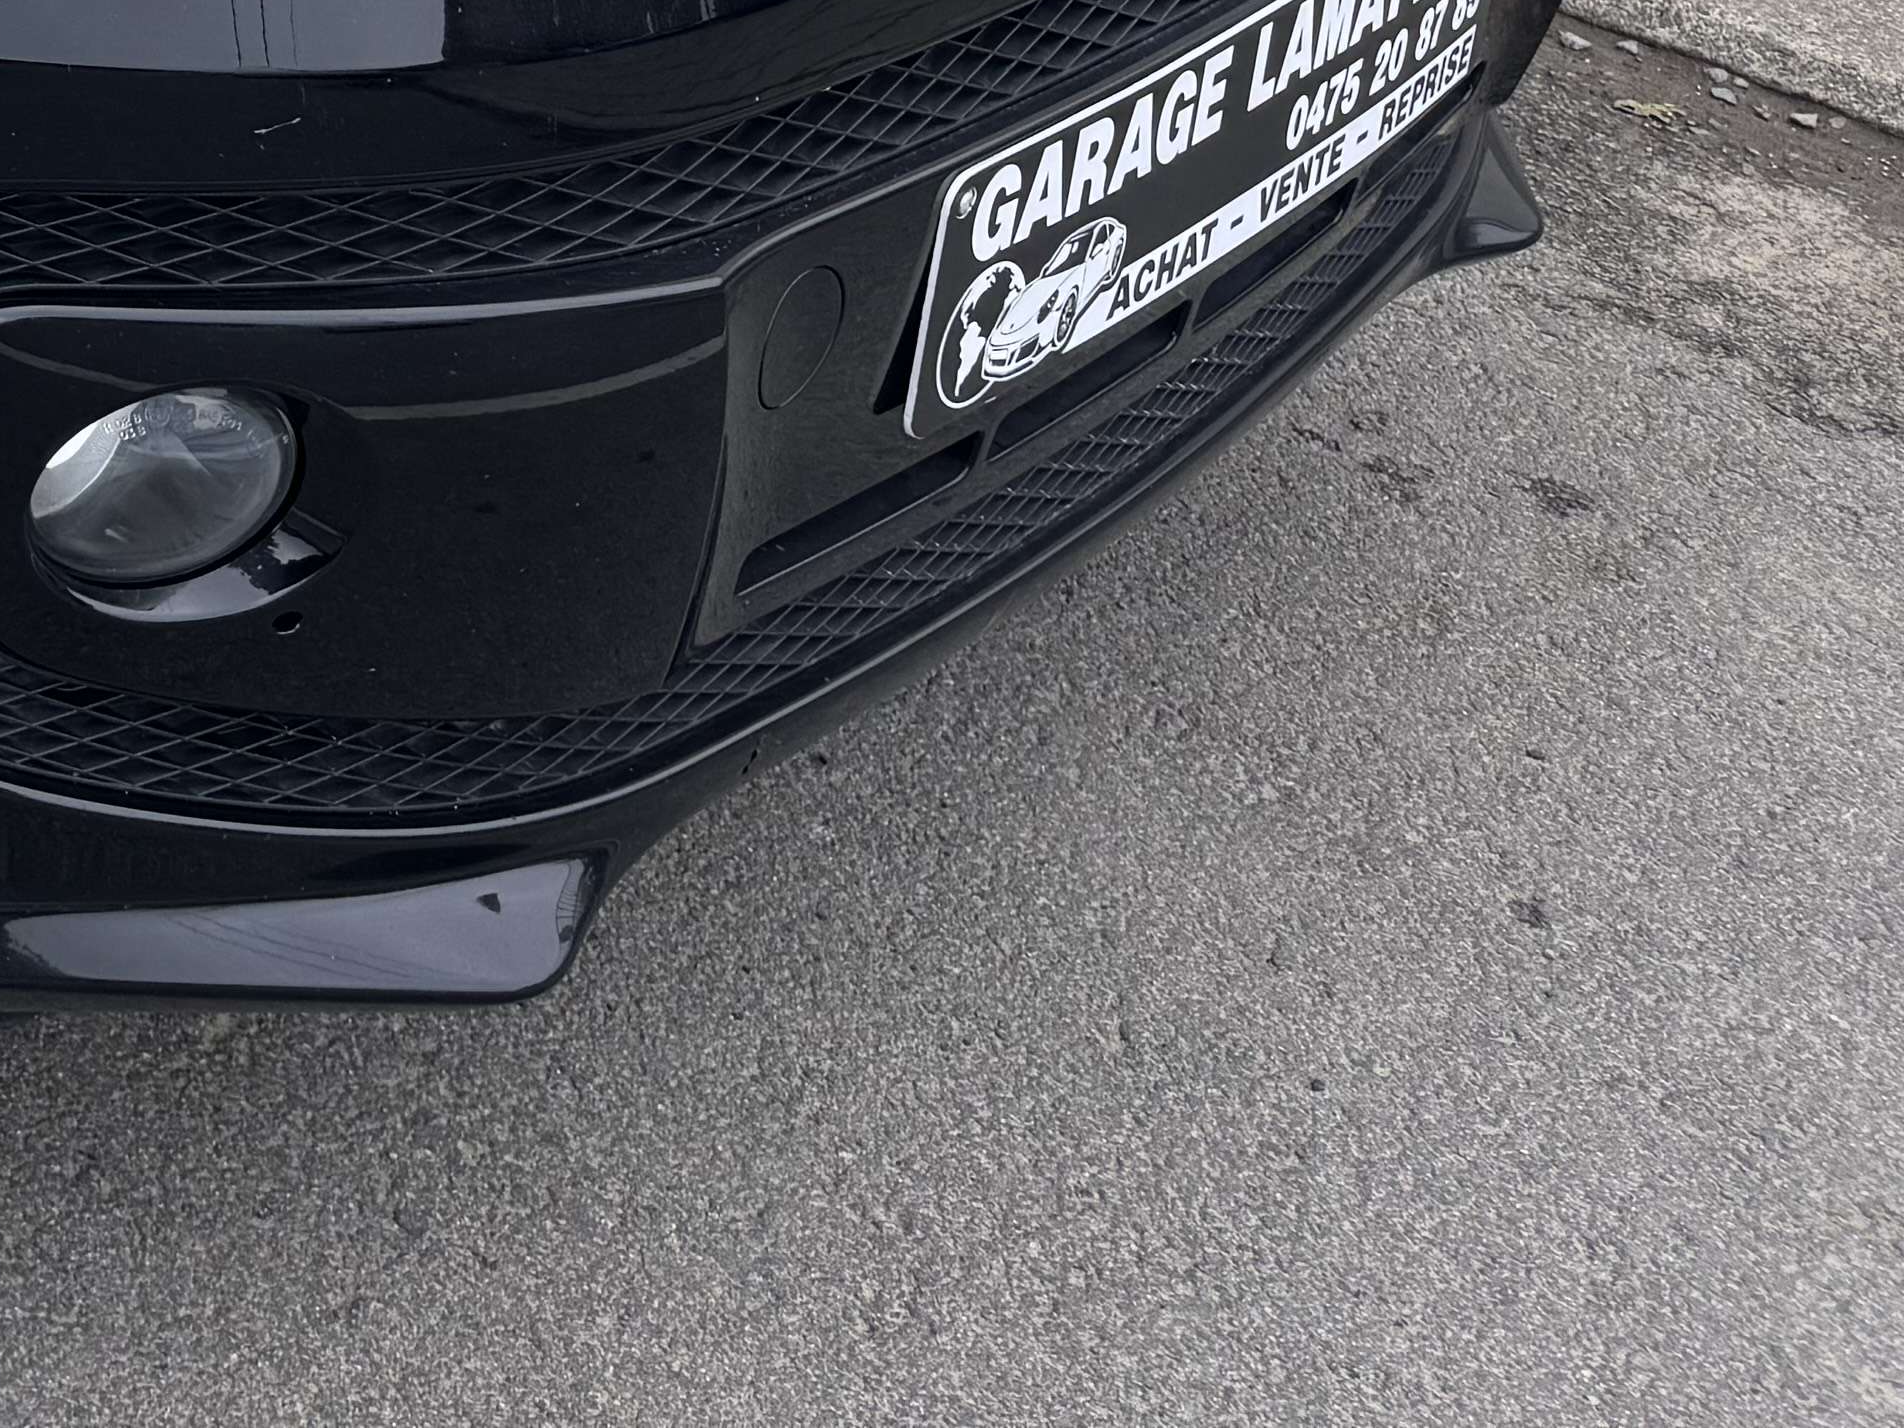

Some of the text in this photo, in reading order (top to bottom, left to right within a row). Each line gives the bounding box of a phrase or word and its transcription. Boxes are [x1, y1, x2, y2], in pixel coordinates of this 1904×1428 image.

[971, 45, 1234, 262] GARAGE
[1107, 221, 1218, 322] ACHAT
[1260, 142, 1344, 220] VENTE
[1381, 30, 1474, 140] REPRISE
[1286, 62, 1362, 150] 0475
[1369, 38, 1405, 104] 20
[1415, 0, 1451, 63] 87
